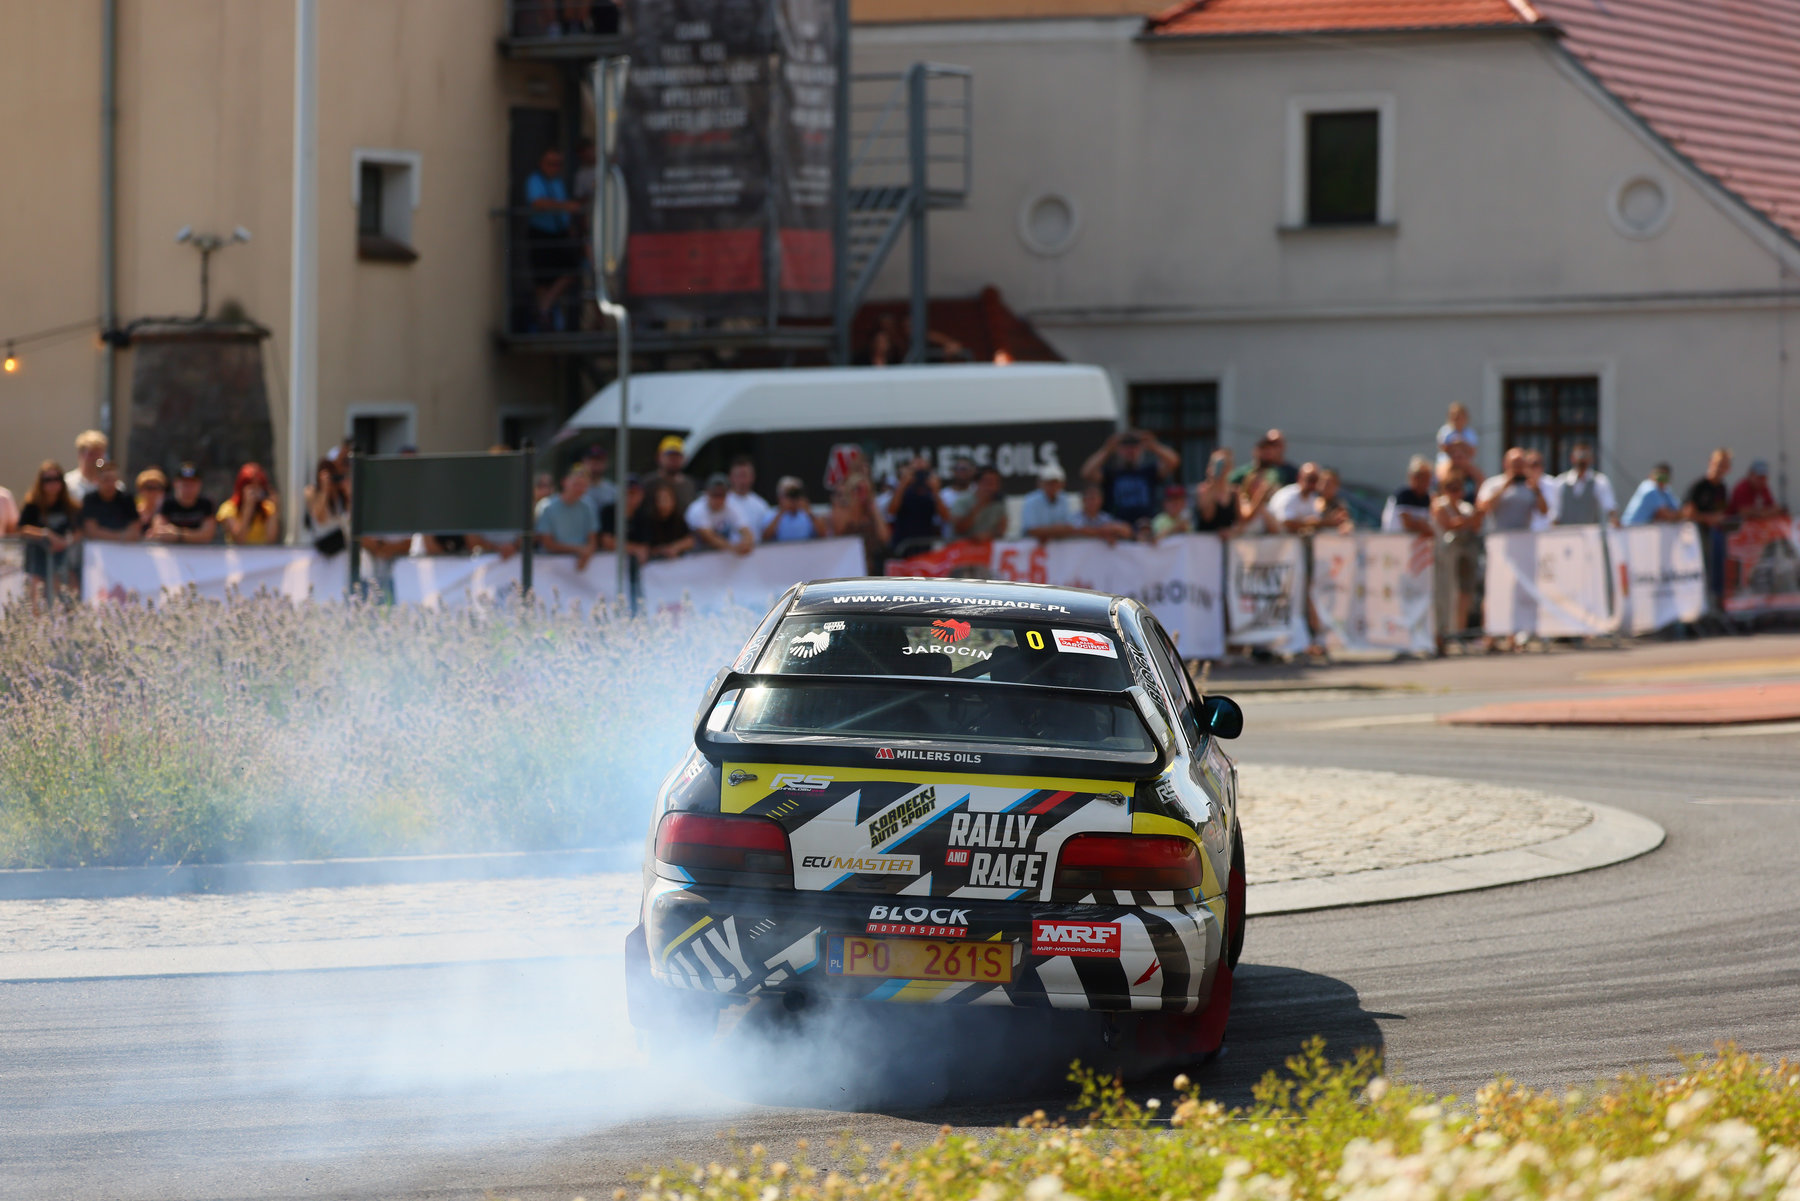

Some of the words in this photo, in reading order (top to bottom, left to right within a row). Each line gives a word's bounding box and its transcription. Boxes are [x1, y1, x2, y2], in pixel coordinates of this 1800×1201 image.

[832, 595, 1071, 615] WWW.RALLYANDRACE.PL
[1025, 630, 1045, 650] 0
[902, 645, 993, 660] JAROCIN
[896, 750, 951, 762] MILLERS
[953, 753, 982, 764] OILS
[769, 773, 834, 790] RS
[868, 785, 936, 837] KORNECKI
[870, 821, 899, 850] AUTO
[900, 797, 937, 829] SPORT
[948, 812, 1037, 848] RALLY
[947, 851, 967, 863] AND
[969, 852, 1042, 888] RACE
[869, 905, 972, 926] BLOCK
[868, 923, 966, 936] MOTORSPORT
[1036, 924, 1117, 944] MRF
[830, 959, 842, 968] PL
[924, 944, 1002, 978] 261S
